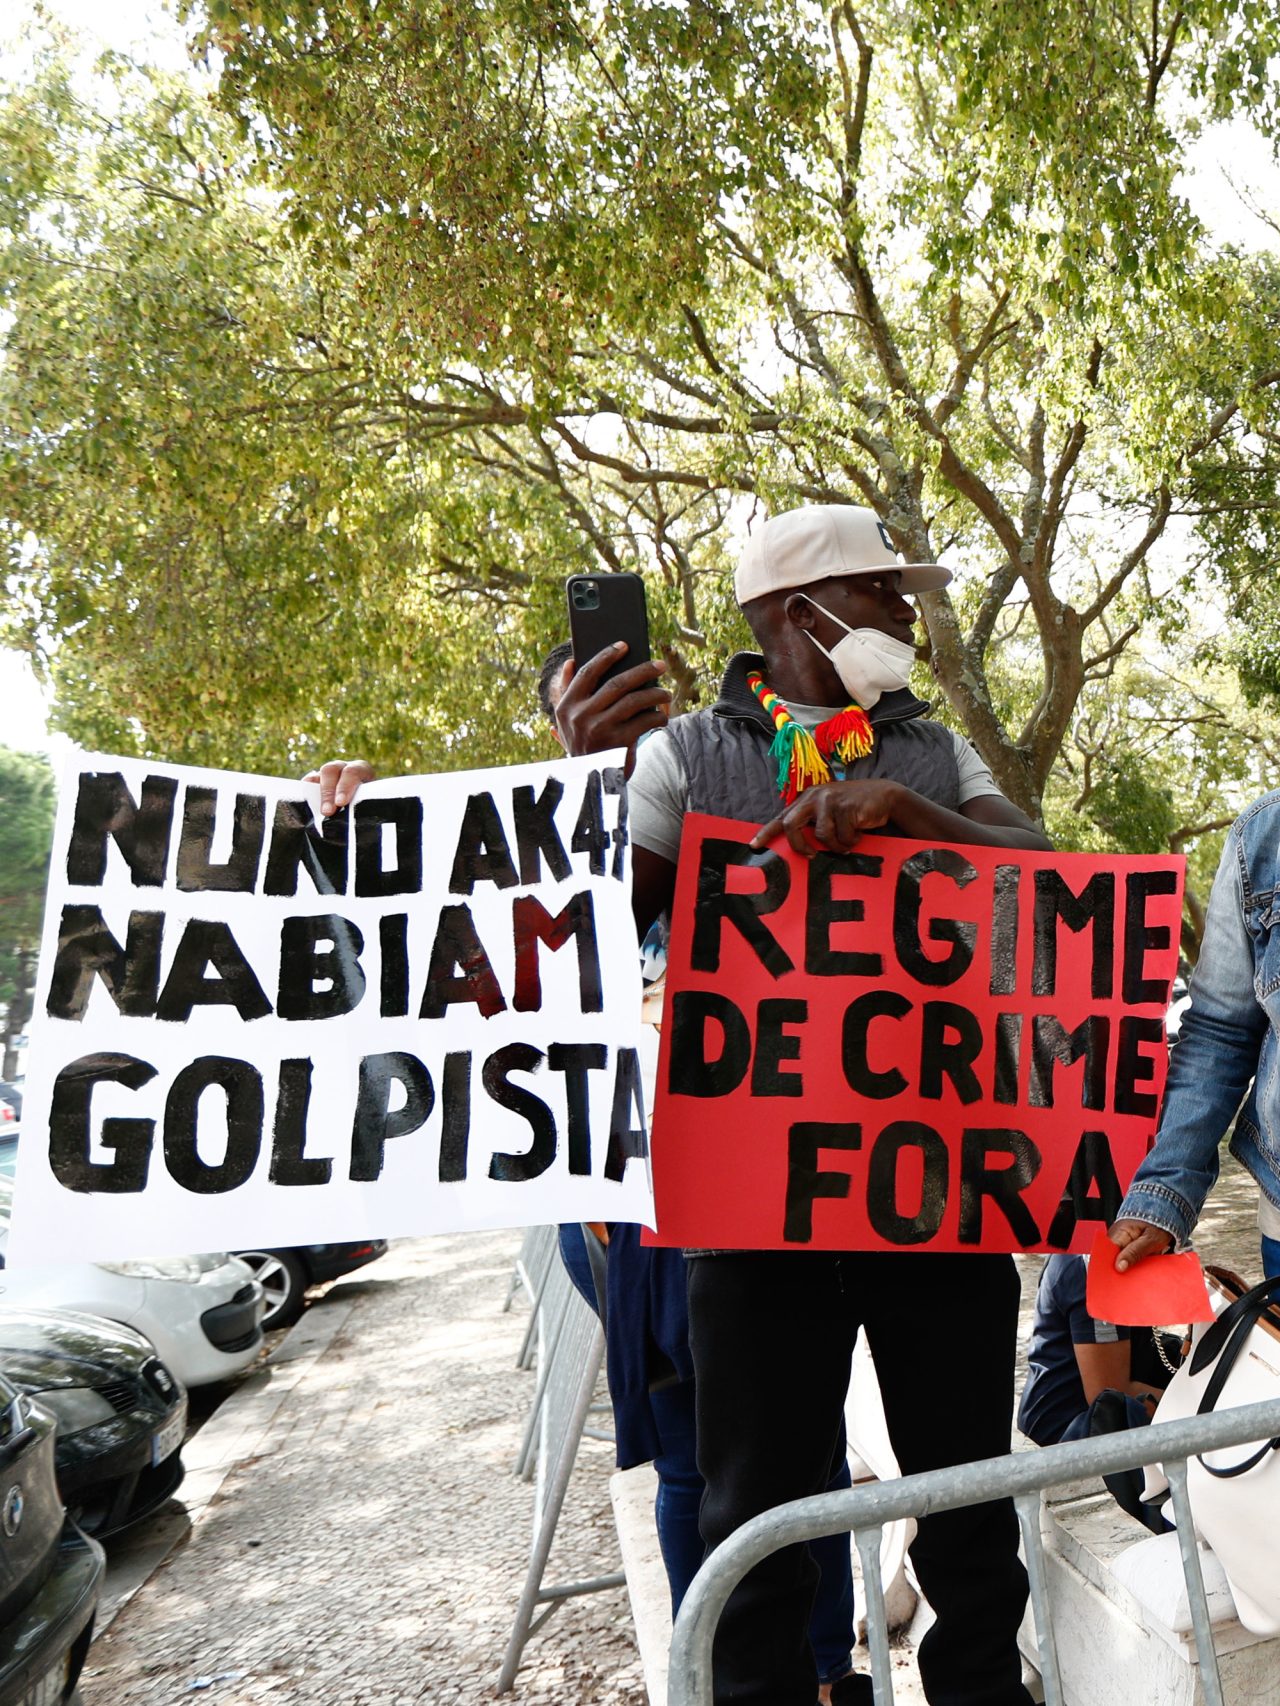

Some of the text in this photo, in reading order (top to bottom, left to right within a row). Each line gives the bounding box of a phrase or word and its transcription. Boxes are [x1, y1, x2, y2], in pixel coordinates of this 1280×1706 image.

[67, 766, 629, 898] NUNO AK47
[46, 889, 604, 1024] NABIAM
[690, 837, 1179, 1004] REGIME
[48, 1042, 652, 1194] GOLPISTA
[668, 990, 1167, 1118] DE CRIME
